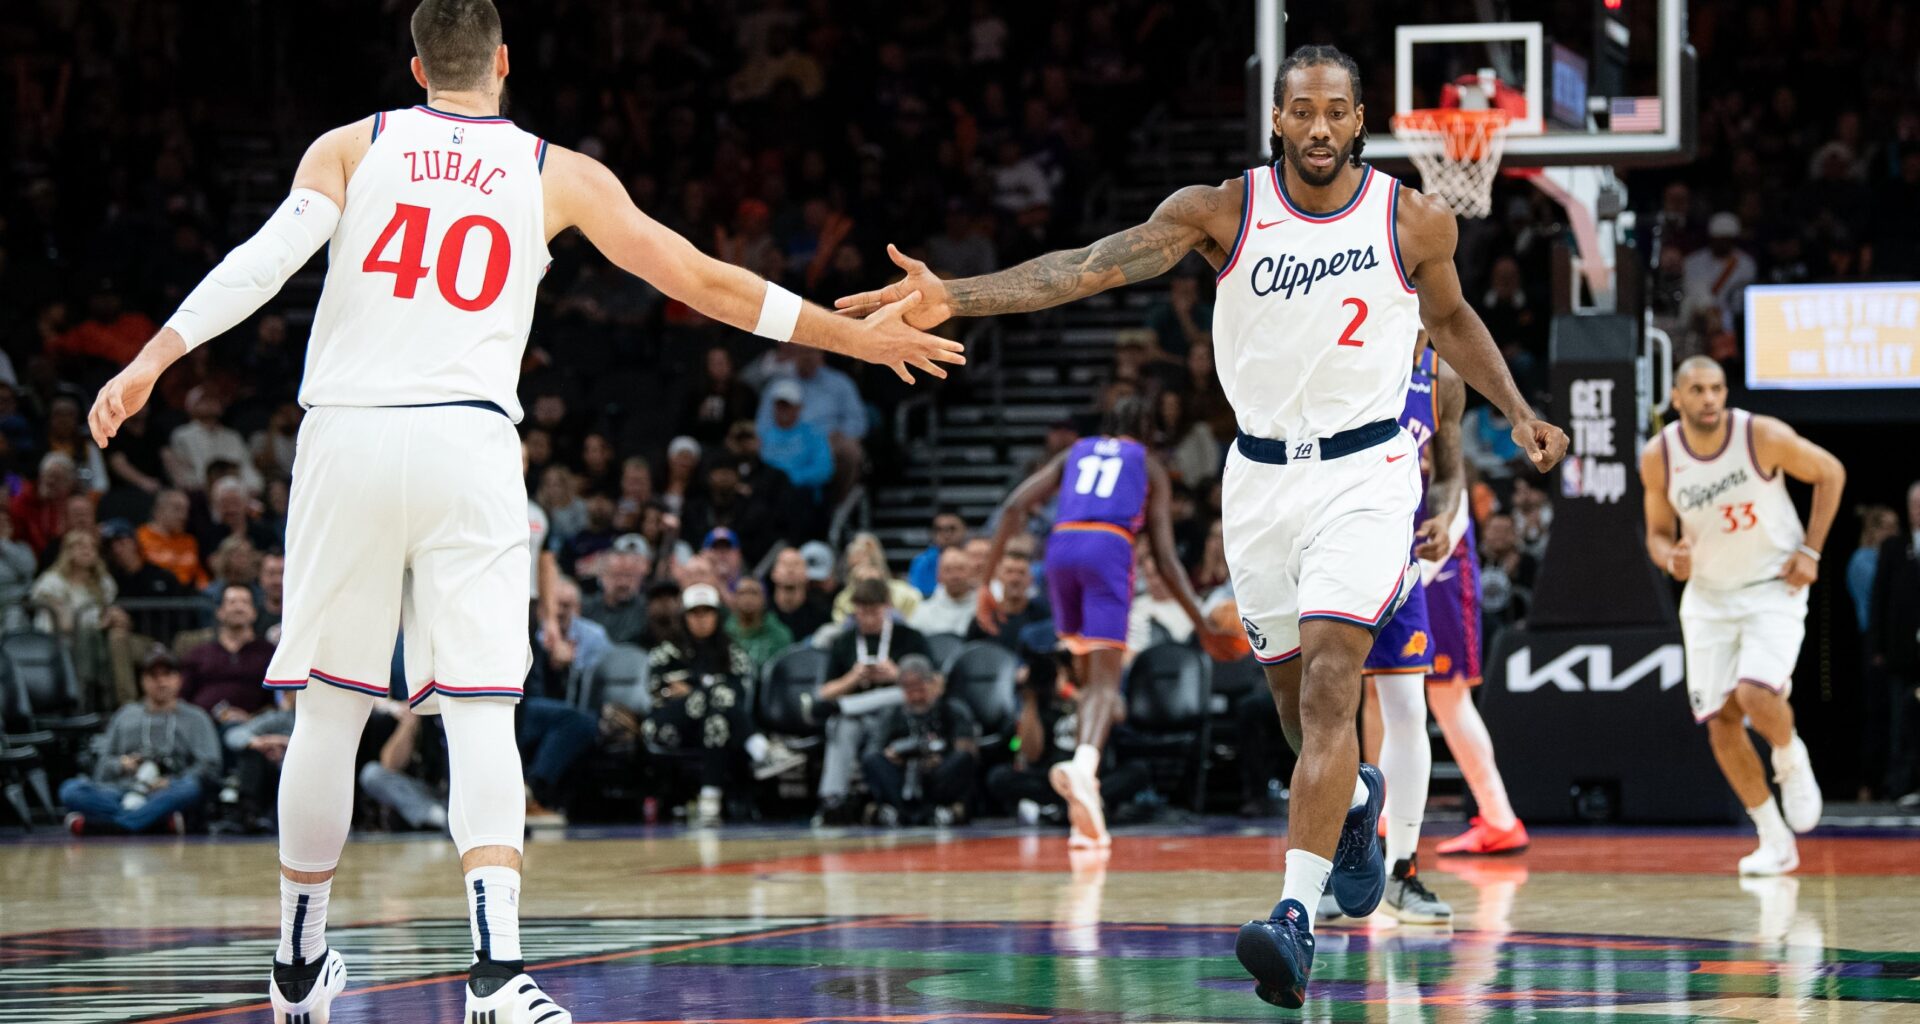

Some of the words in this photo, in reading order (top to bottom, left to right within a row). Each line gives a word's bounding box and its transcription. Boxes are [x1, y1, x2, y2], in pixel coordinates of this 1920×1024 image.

[403, 150, 506, 195] ZUBAC
[362, 202, 511, 312] 40
[1251, 245, 1379, 300] Clippers
[1337, 297, 1370, 348] 2
[1570, 379, 1615, 417] GET
[1293, 443, 1313, 459] LA
[1570, 417, 1616, 456] THE
[1075, 454, 1123, 498] 11
[1583, 456, 1627, 503] App
[1677, 467, 1748, 512] Clippers
[1718, 501, 1758, 533] 33
